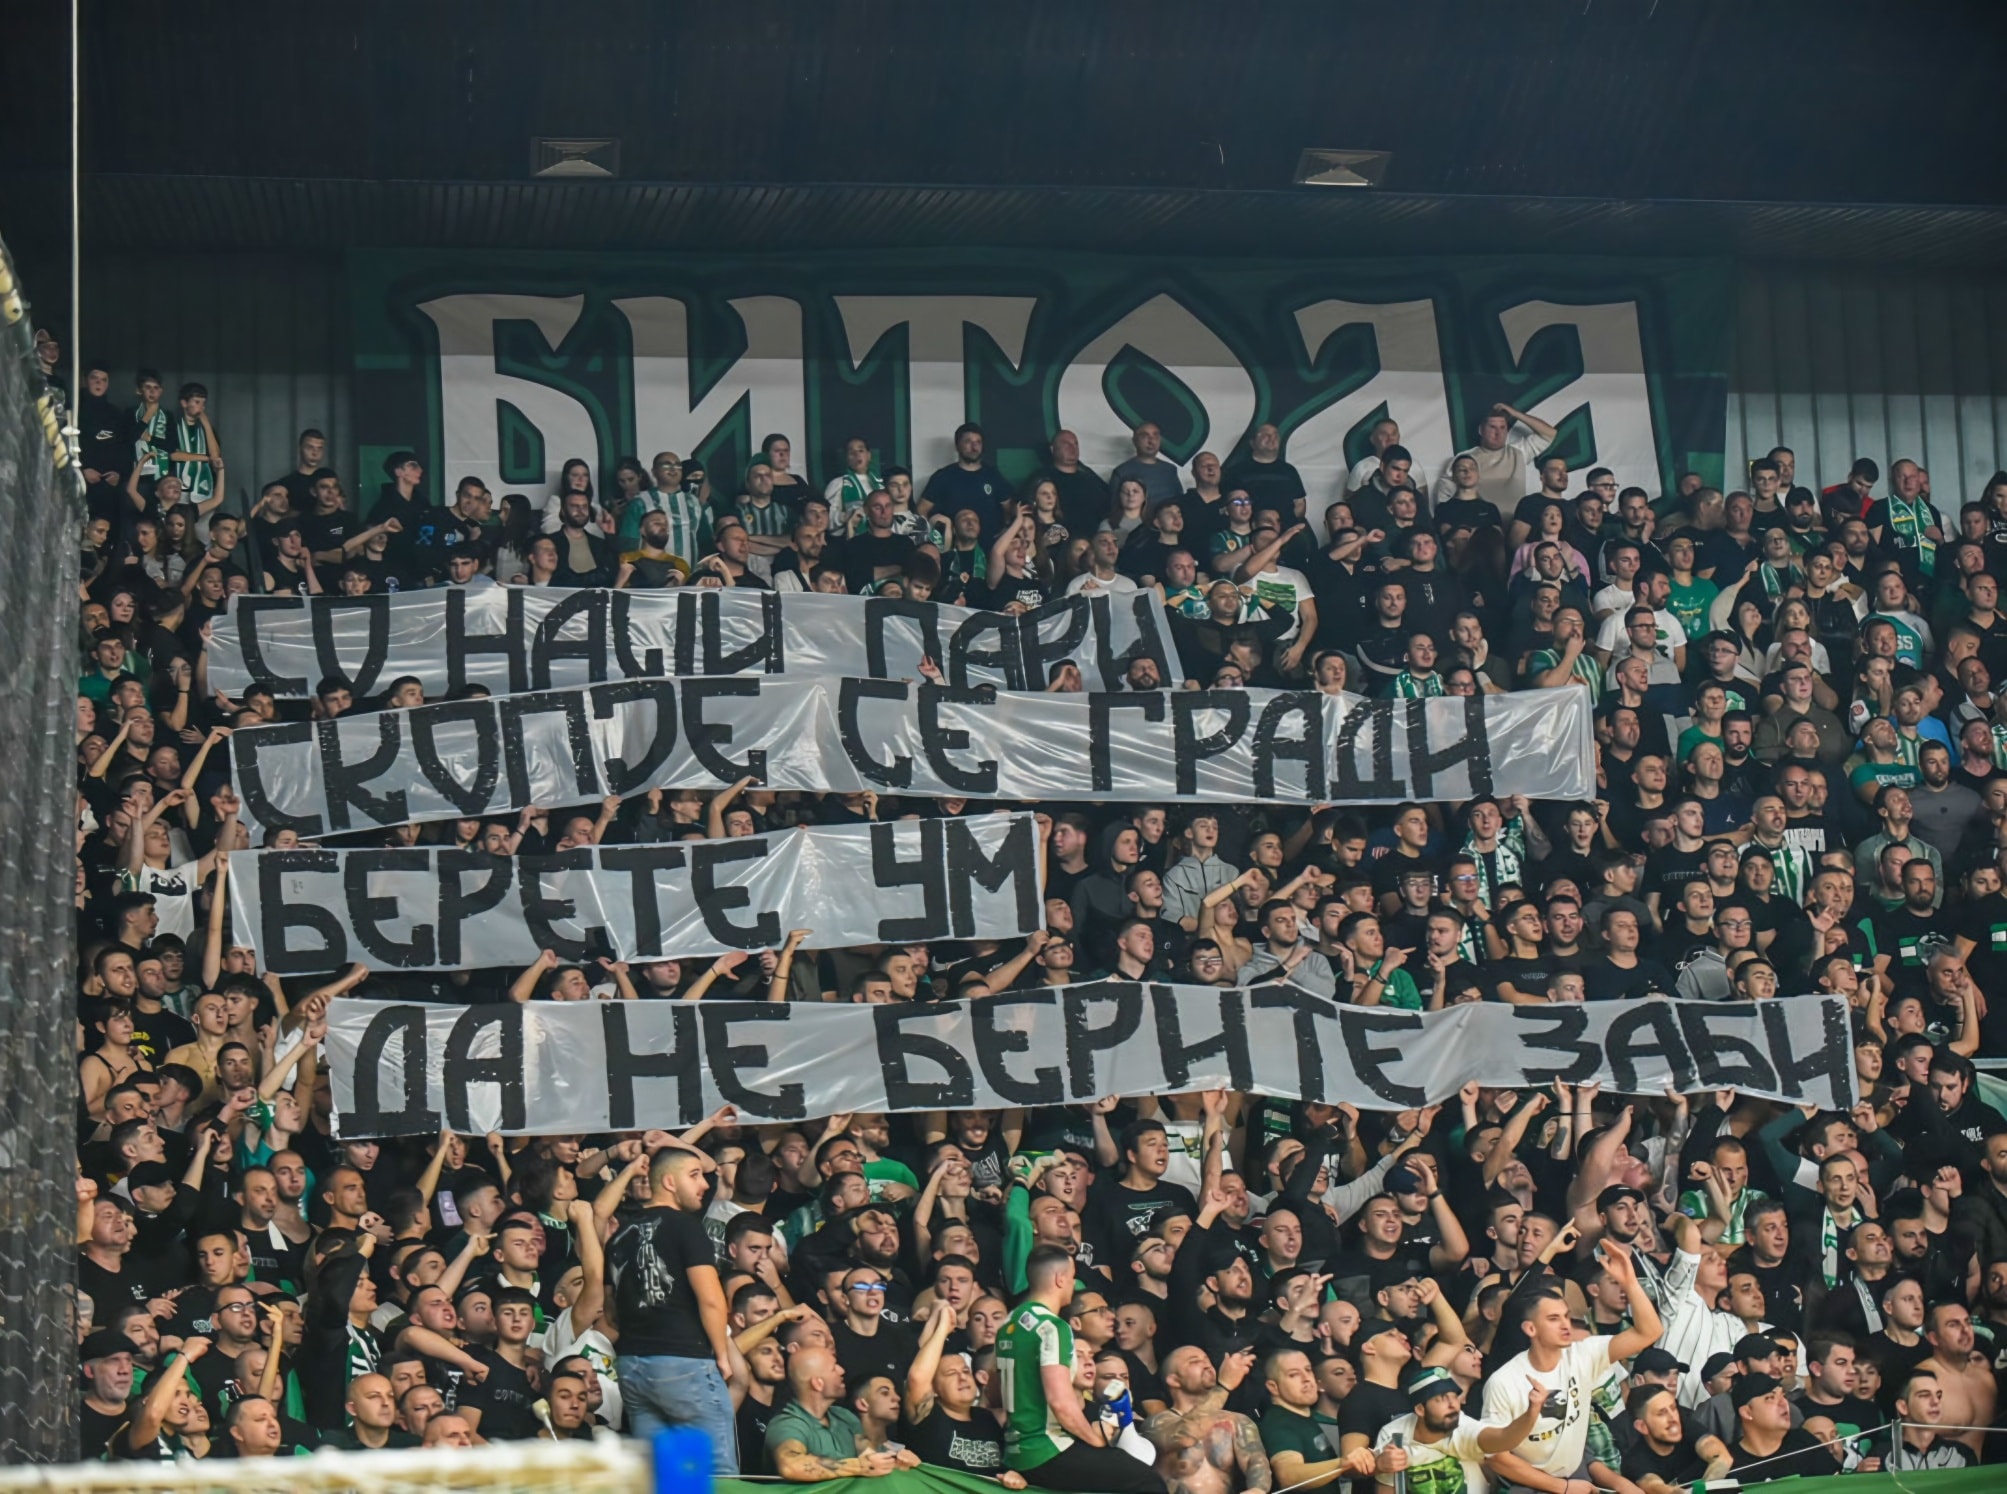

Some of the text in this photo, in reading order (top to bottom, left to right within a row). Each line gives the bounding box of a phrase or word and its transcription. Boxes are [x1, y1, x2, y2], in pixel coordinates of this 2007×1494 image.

[415, 290, 1666, 525] БИТОЛА
[237, 588, 1172, 698] СО НАШИ ПАРИ
[232, 676, 1494, 836] СКОПЈЕ СЕ ГРАДИ
[259, 811, 1041, 974] БЕРЕТЕ УМ
[336, 981, 1855, 1139] ДА НЕ БЕРИТЕ ЗАБИ
